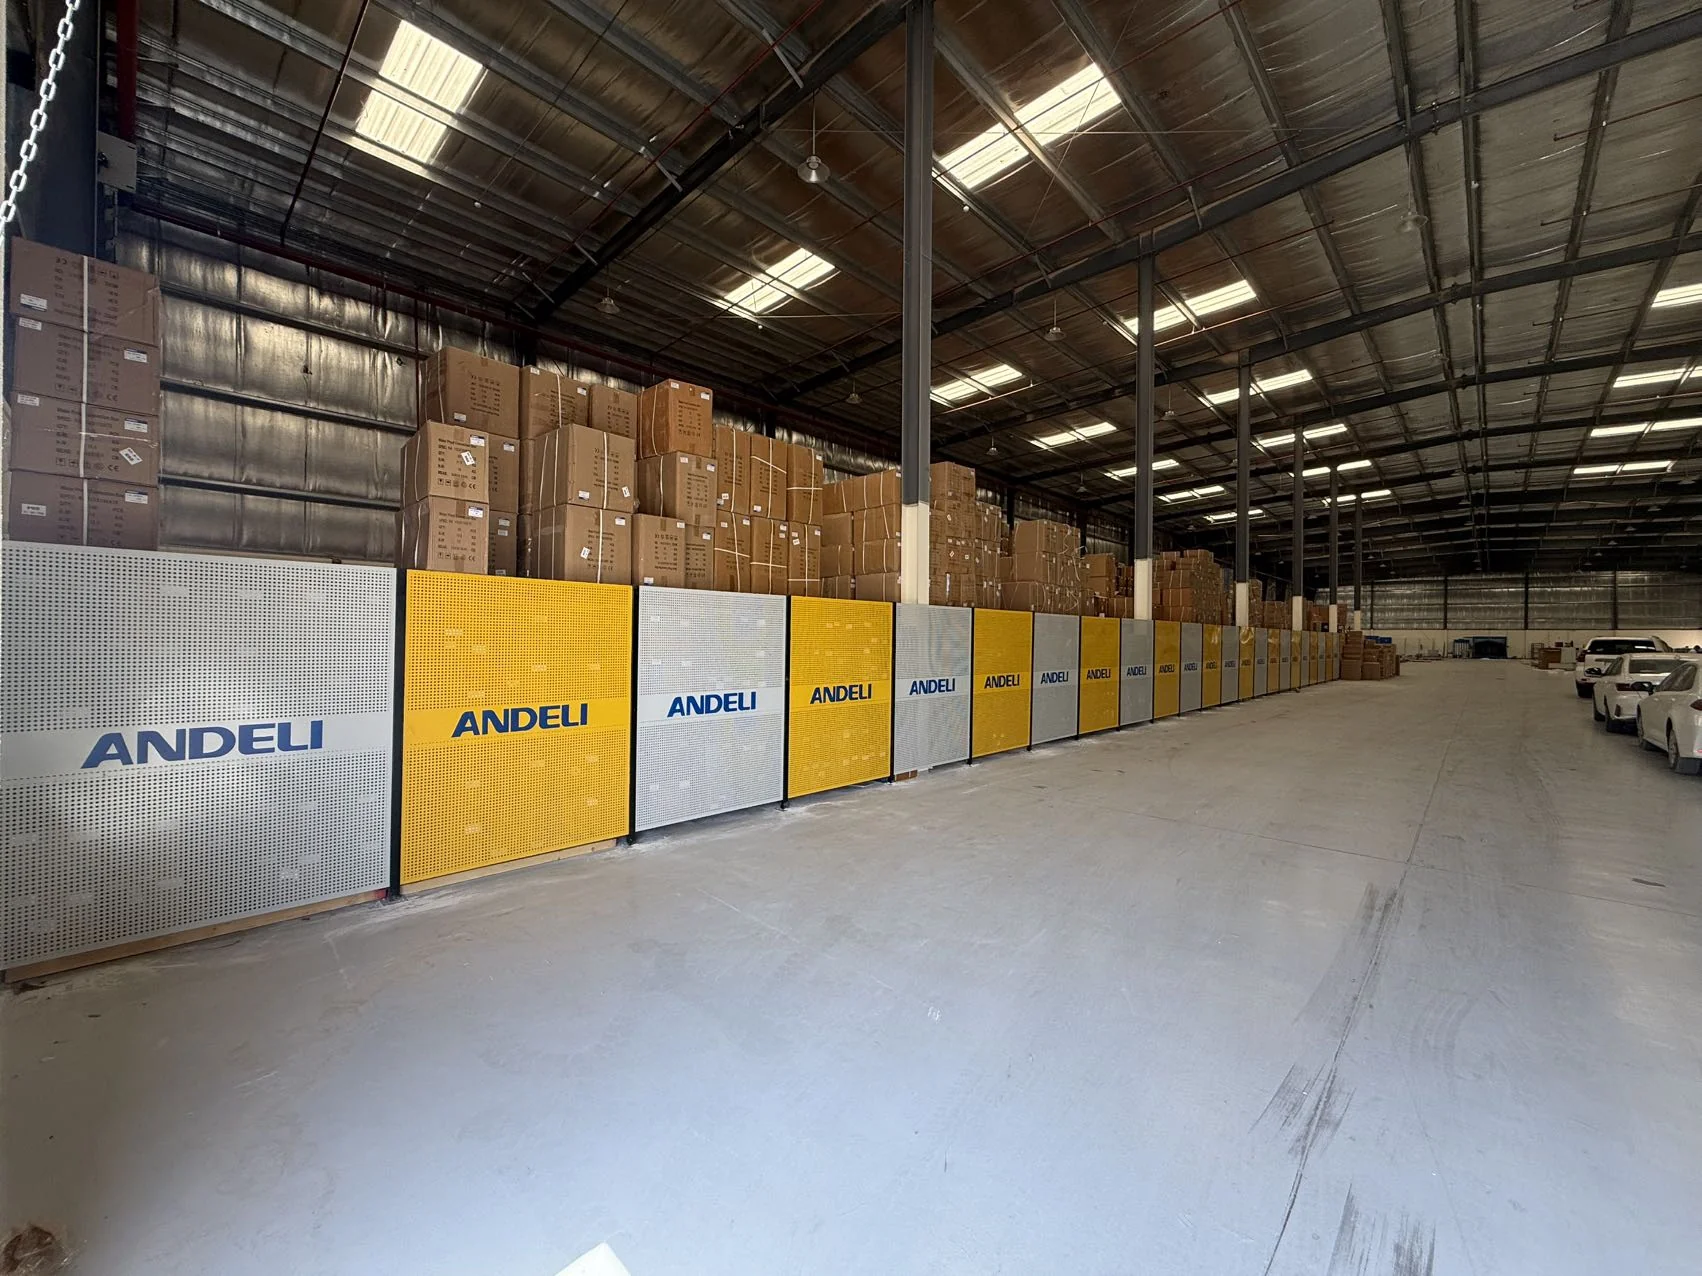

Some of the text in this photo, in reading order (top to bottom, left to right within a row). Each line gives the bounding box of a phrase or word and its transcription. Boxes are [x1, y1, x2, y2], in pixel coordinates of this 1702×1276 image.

[1086, 668, 1111, 680] ANDELI
[1126, 665, 1147, 677] ANDELI
[1159, 664, 1175, 674] ANDELI
[909, 677, 956, 696] ANDELI
[984, 673, 1020, 689] ANDELI
[1040, 671, 1069, 685] ANDELI
[809, 683, 872, 705] ANDELI
[667, 691, 757, 718] ANDELI
[451, 703, 588, 738] ANDELI
[79, 720, 323, 769] ANDELI
